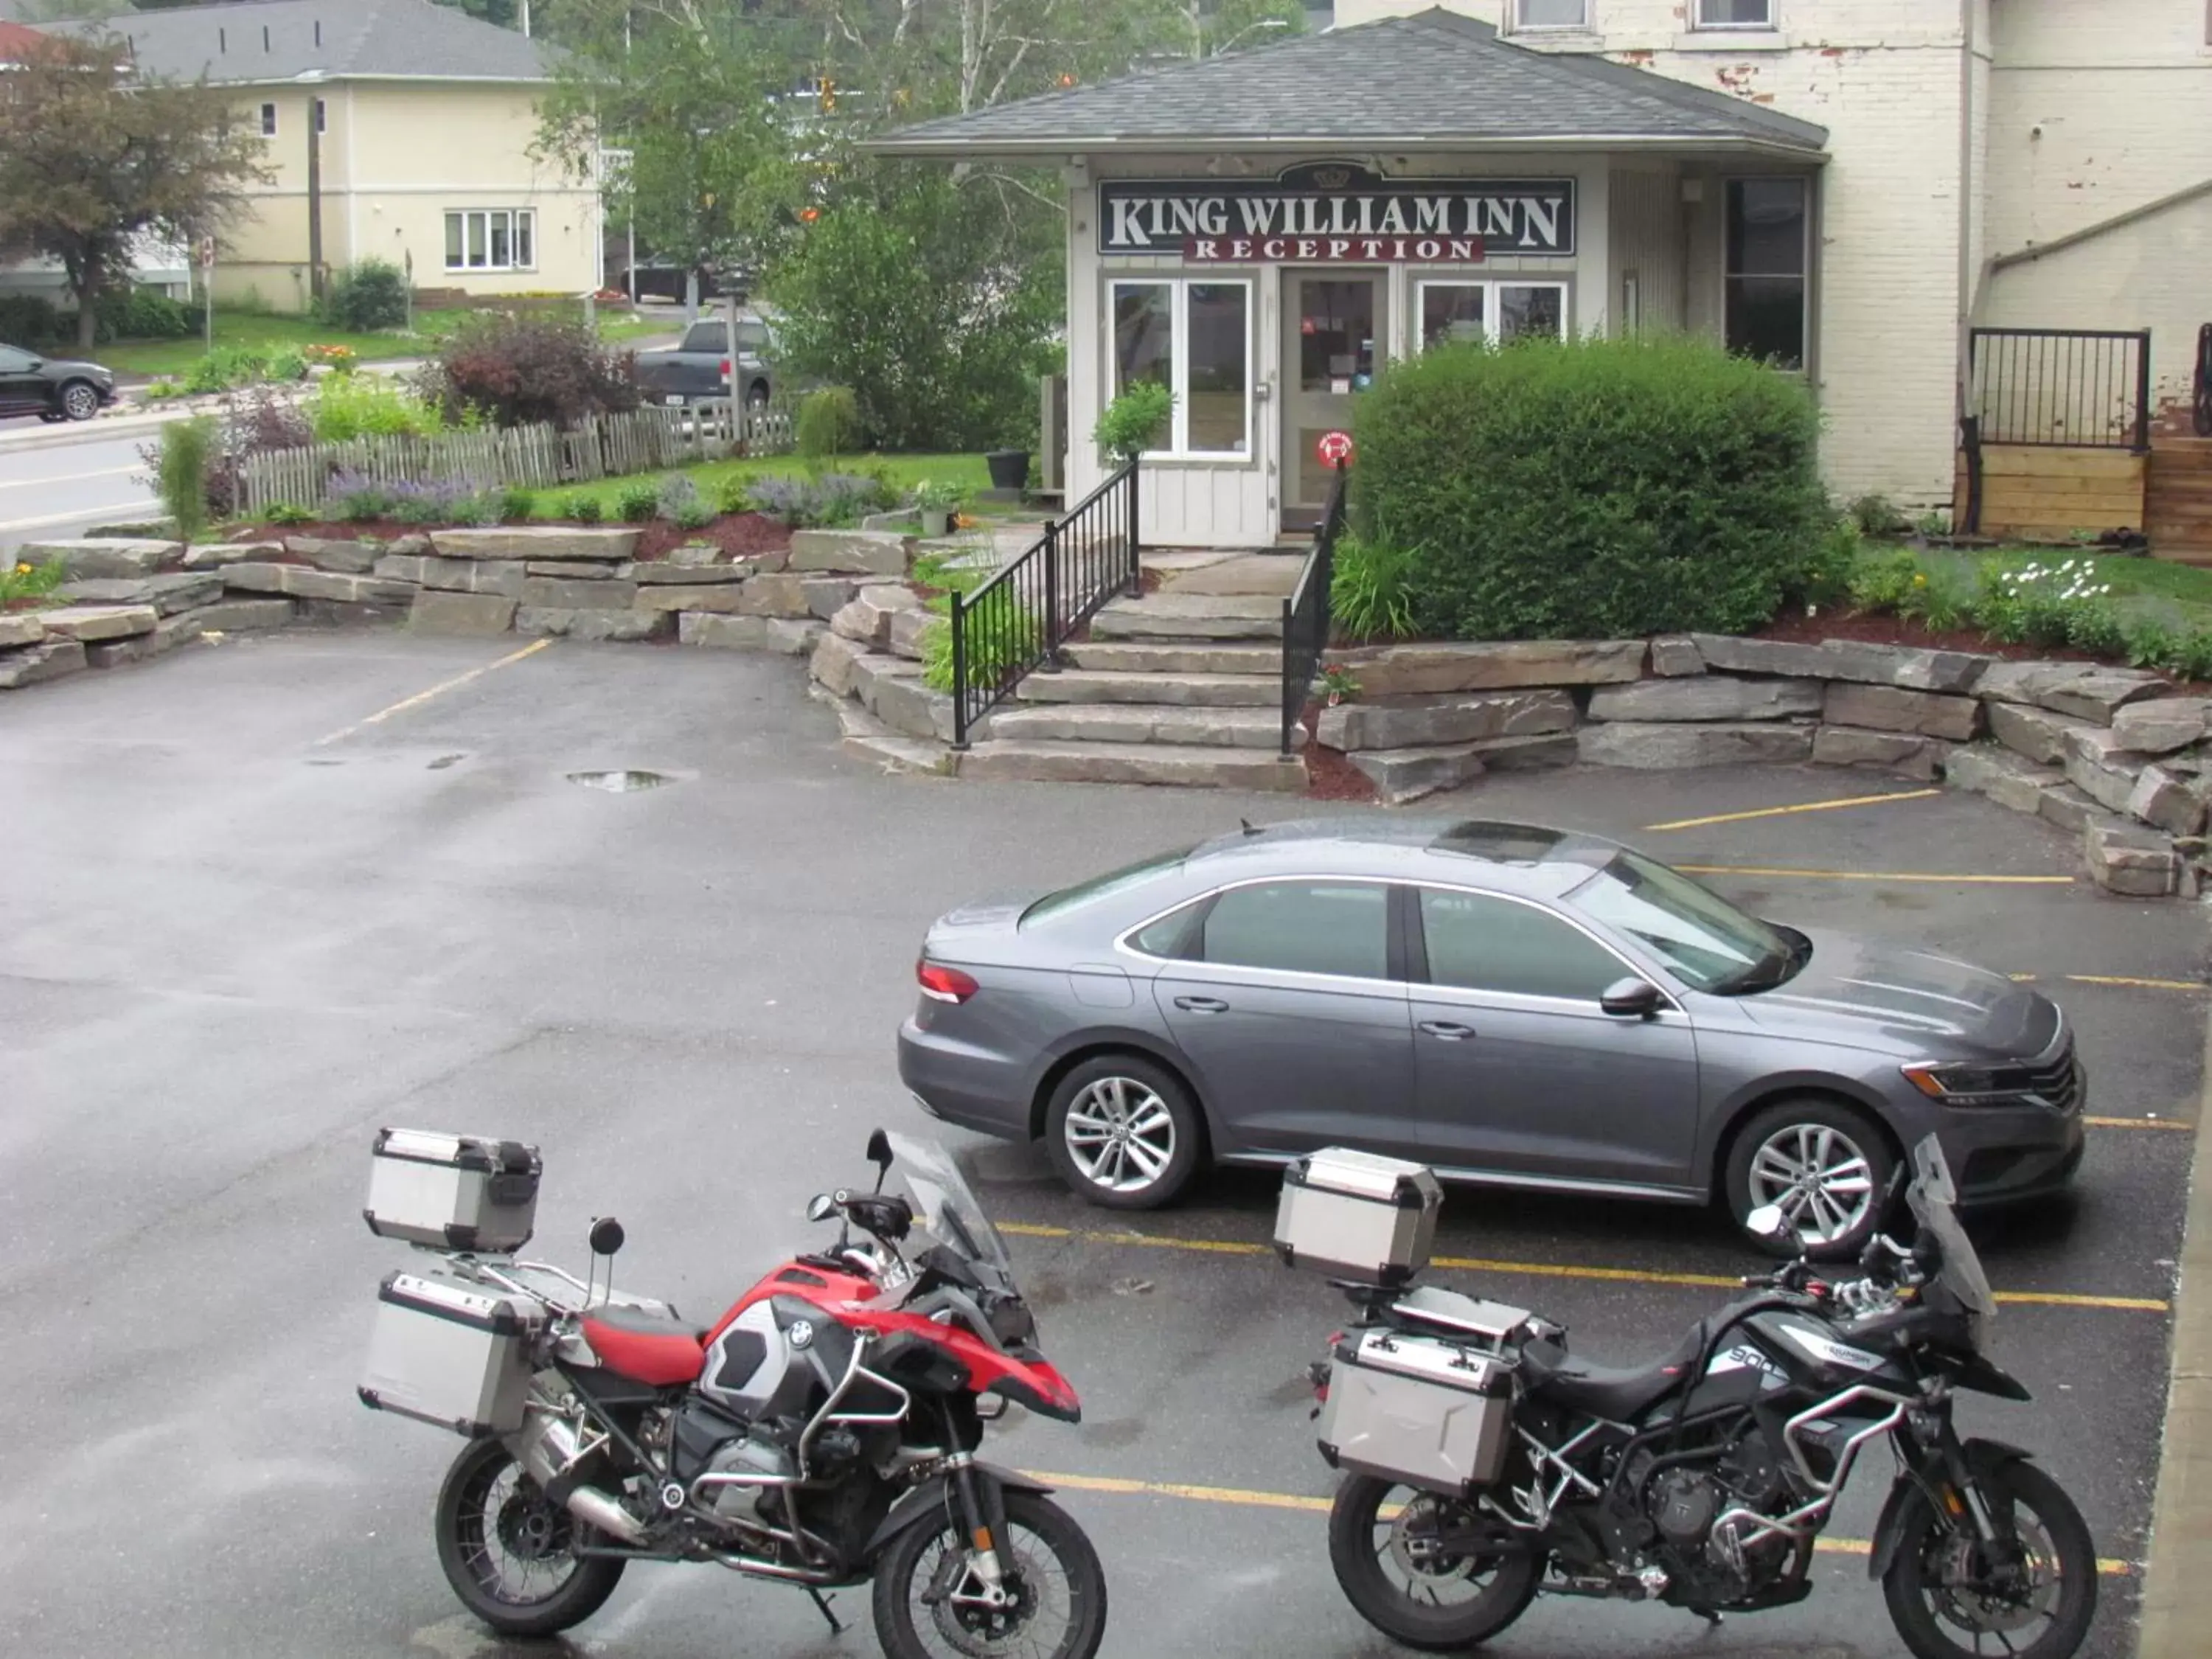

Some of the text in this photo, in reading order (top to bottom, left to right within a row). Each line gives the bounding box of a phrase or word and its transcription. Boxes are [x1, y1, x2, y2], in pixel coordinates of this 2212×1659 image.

[1108, 196, 1563, 247] KING WILLIAM INN
[1195, 240, 1474, 259] RECEPTION
